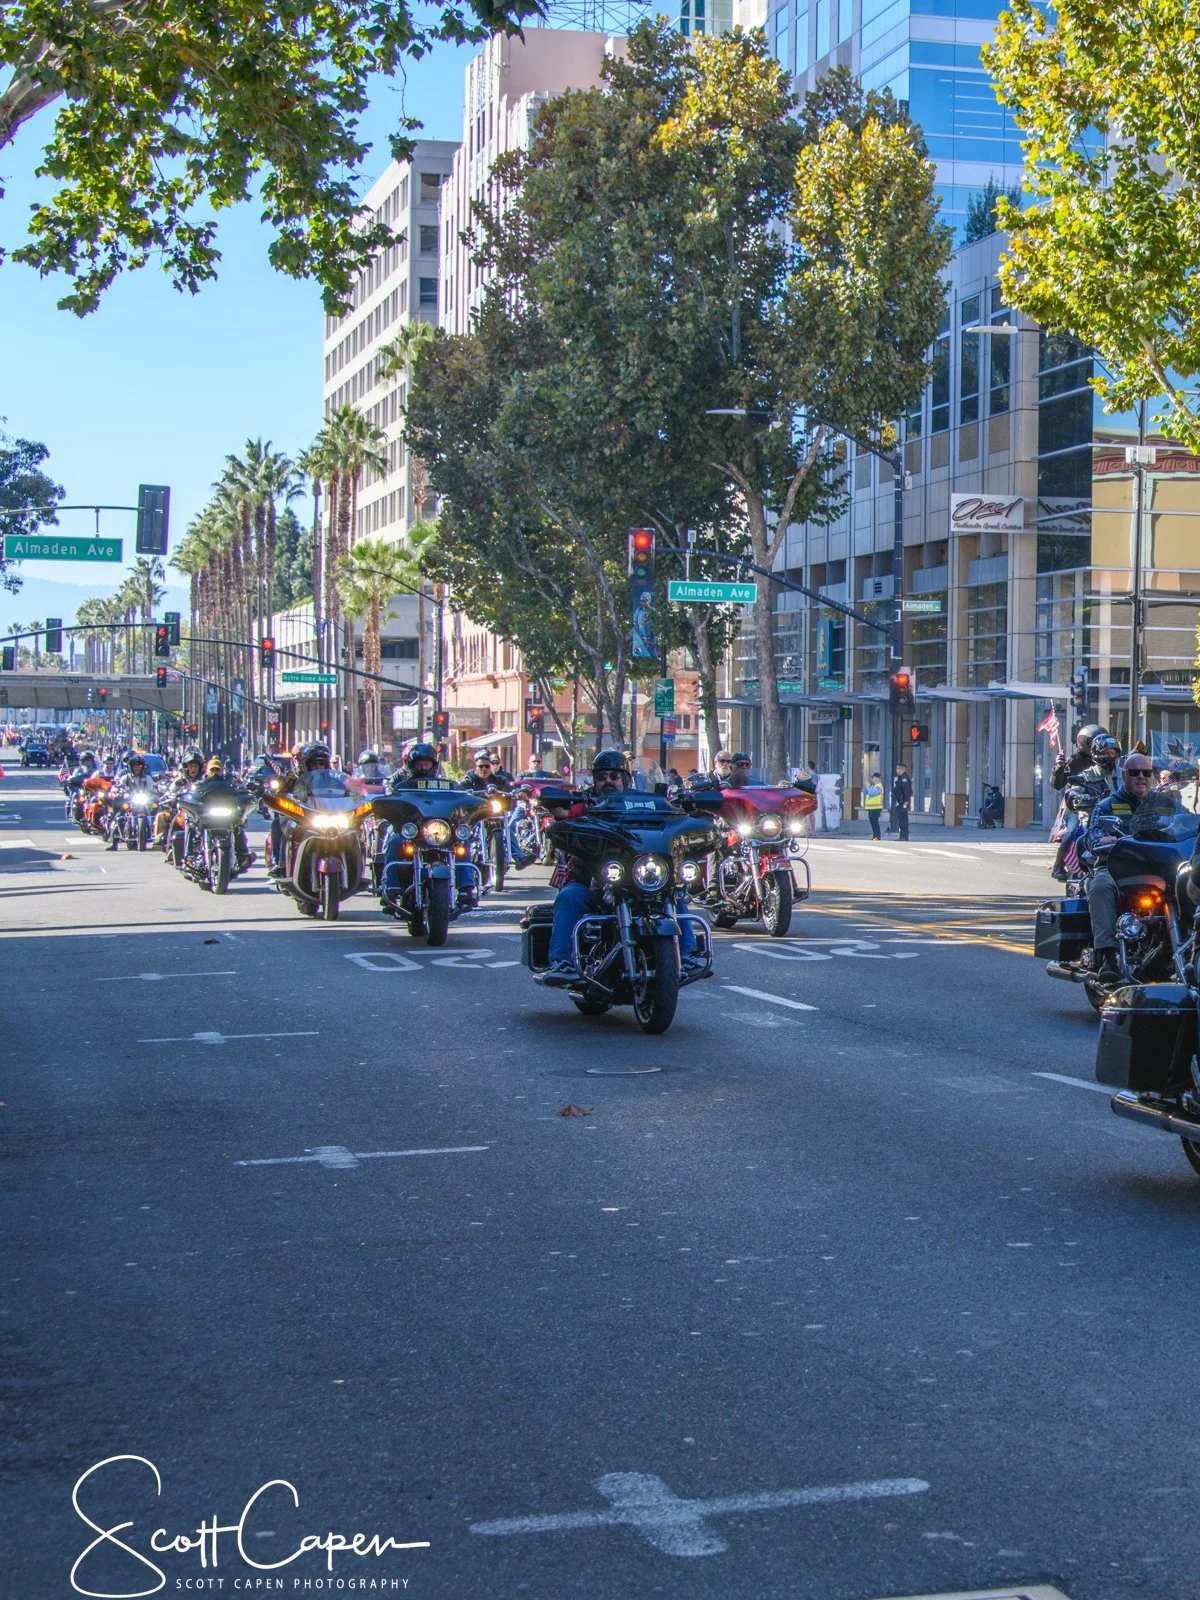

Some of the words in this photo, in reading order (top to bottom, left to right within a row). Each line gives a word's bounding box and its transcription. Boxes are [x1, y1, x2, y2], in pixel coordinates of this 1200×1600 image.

[14, 542, 77, 556] Almaden
[87, 544, 114, 557] Ave
[676, 586, 723, 597] Almaden
[730, 588, 750, 598] Ave
[905, 602, 934, 610] Almaden
